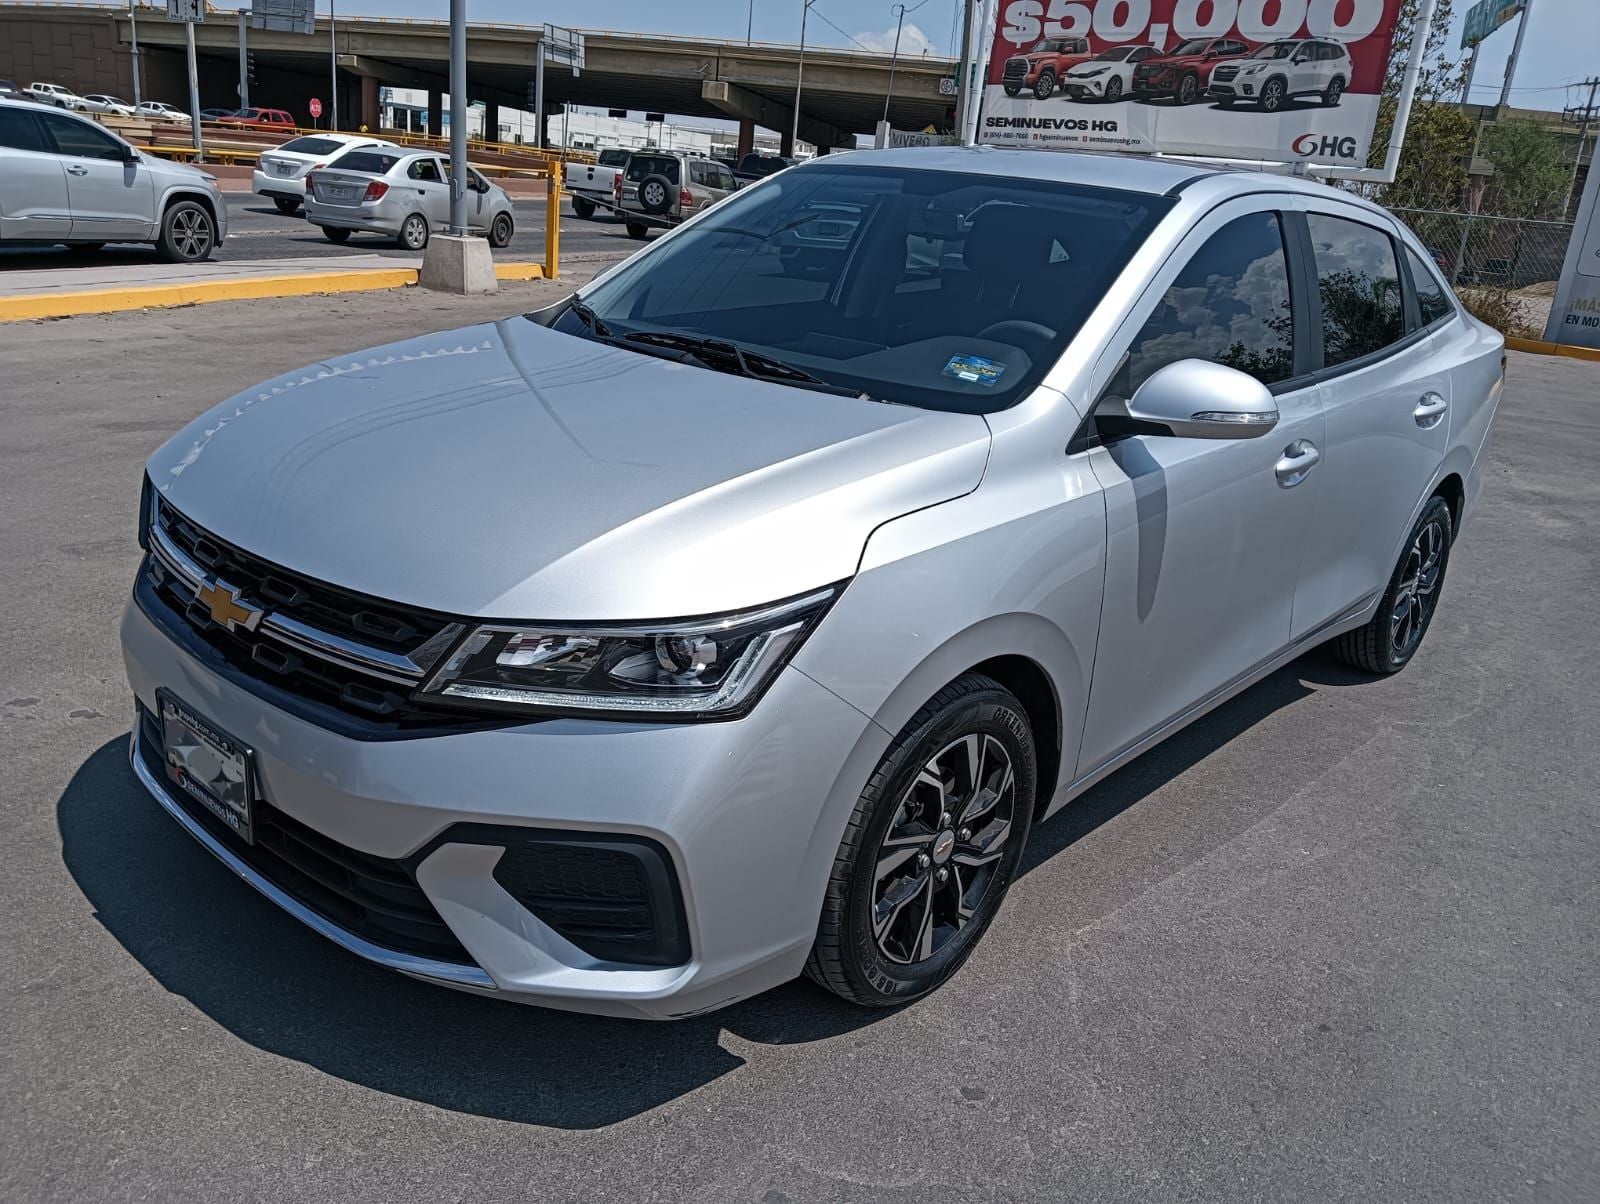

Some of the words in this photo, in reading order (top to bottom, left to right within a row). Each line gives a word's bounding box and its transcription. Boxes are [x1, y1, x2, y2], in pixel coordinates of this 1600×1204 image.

[986, 117, 1088, 130] SEMINUEVOS
[1091, 120, 1118, 132] HG
[1565, 314, 1580, 325] EN
[1582, 315, 1600, 328] MO
